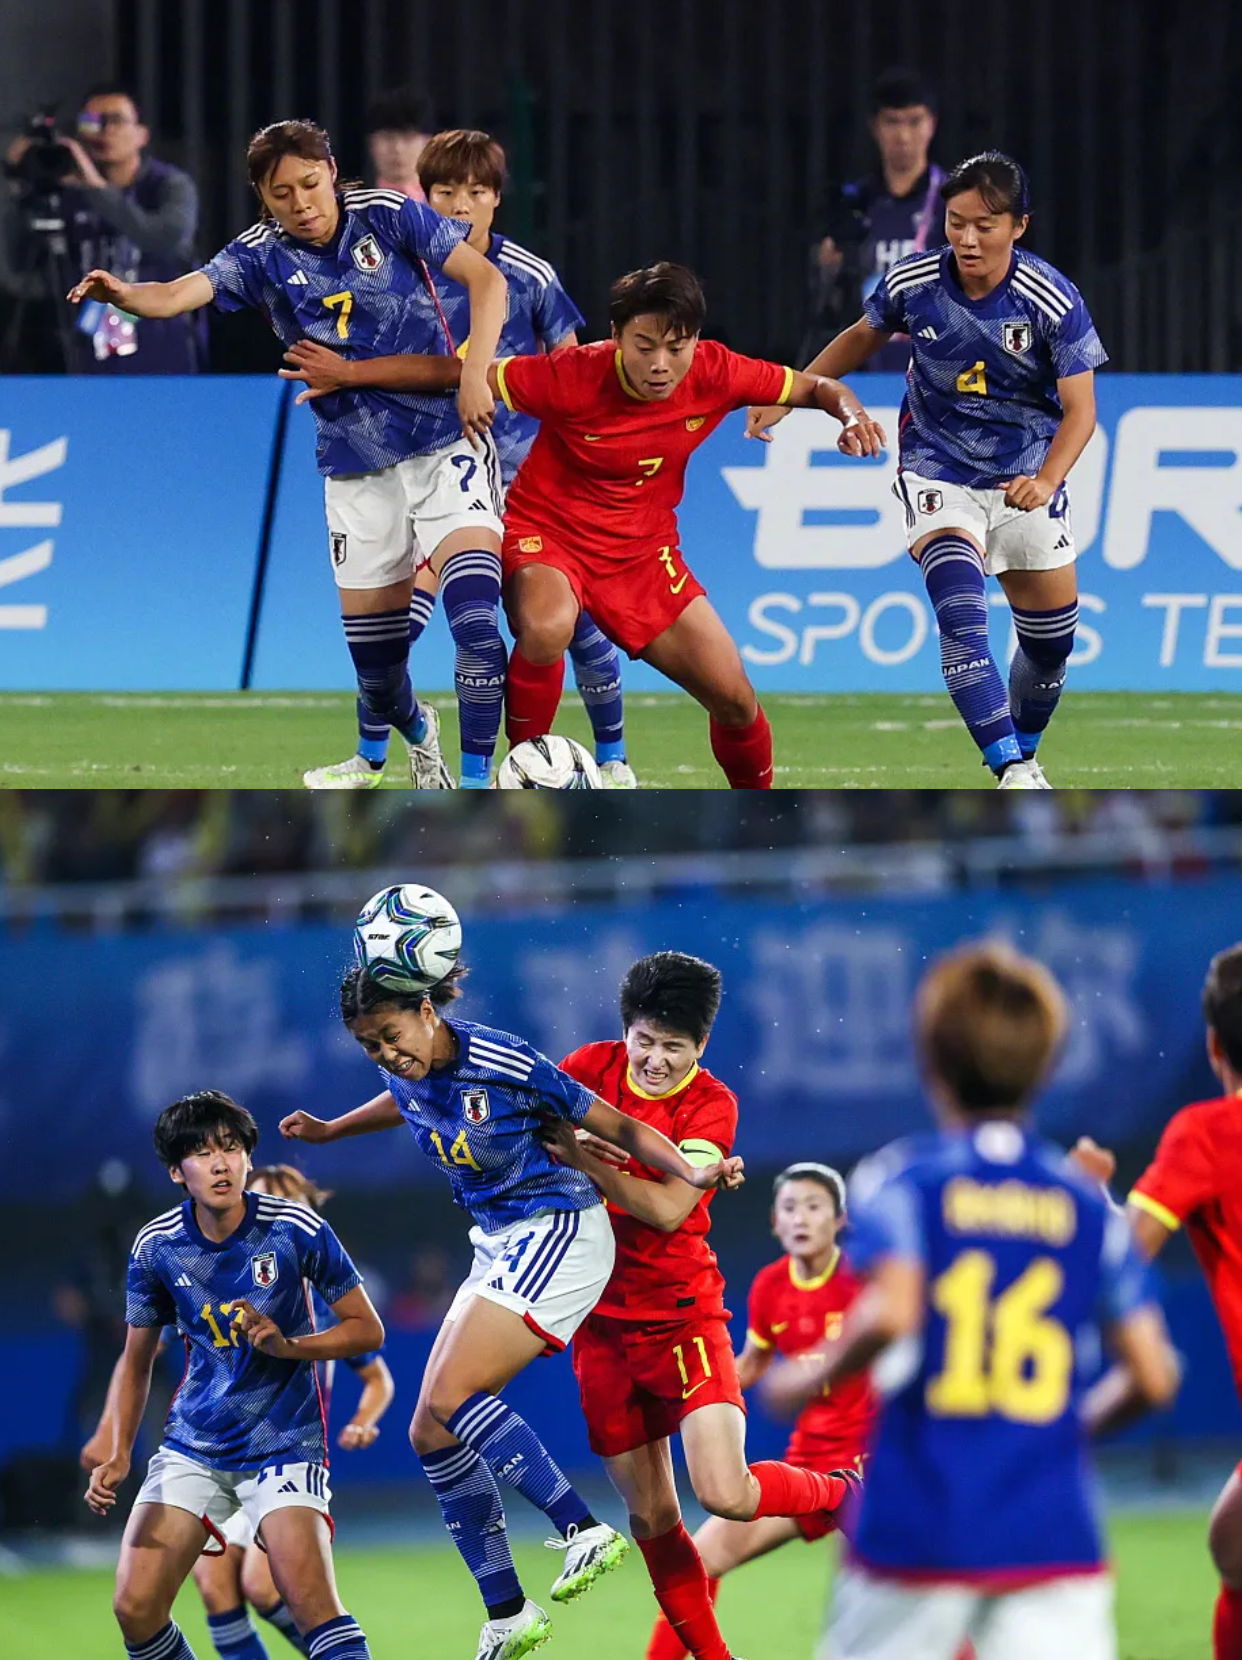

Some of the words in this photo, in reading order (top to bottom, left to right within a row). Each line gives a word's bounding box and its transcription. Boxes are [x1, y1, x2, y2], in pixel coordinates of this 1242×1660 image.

[322, 290, 353, 339] 7
[956, 360, 988, 396] 4
[450, 454, 478, 493] 7
[740, 592, 1107, 667] SPOTS
[942, 657, 991, 677] JAPAN
[429, 1129, 483, 1171] 14
[927, 1250, 1074, 1425] 16
[673, 1336, 712, 1385] 11
